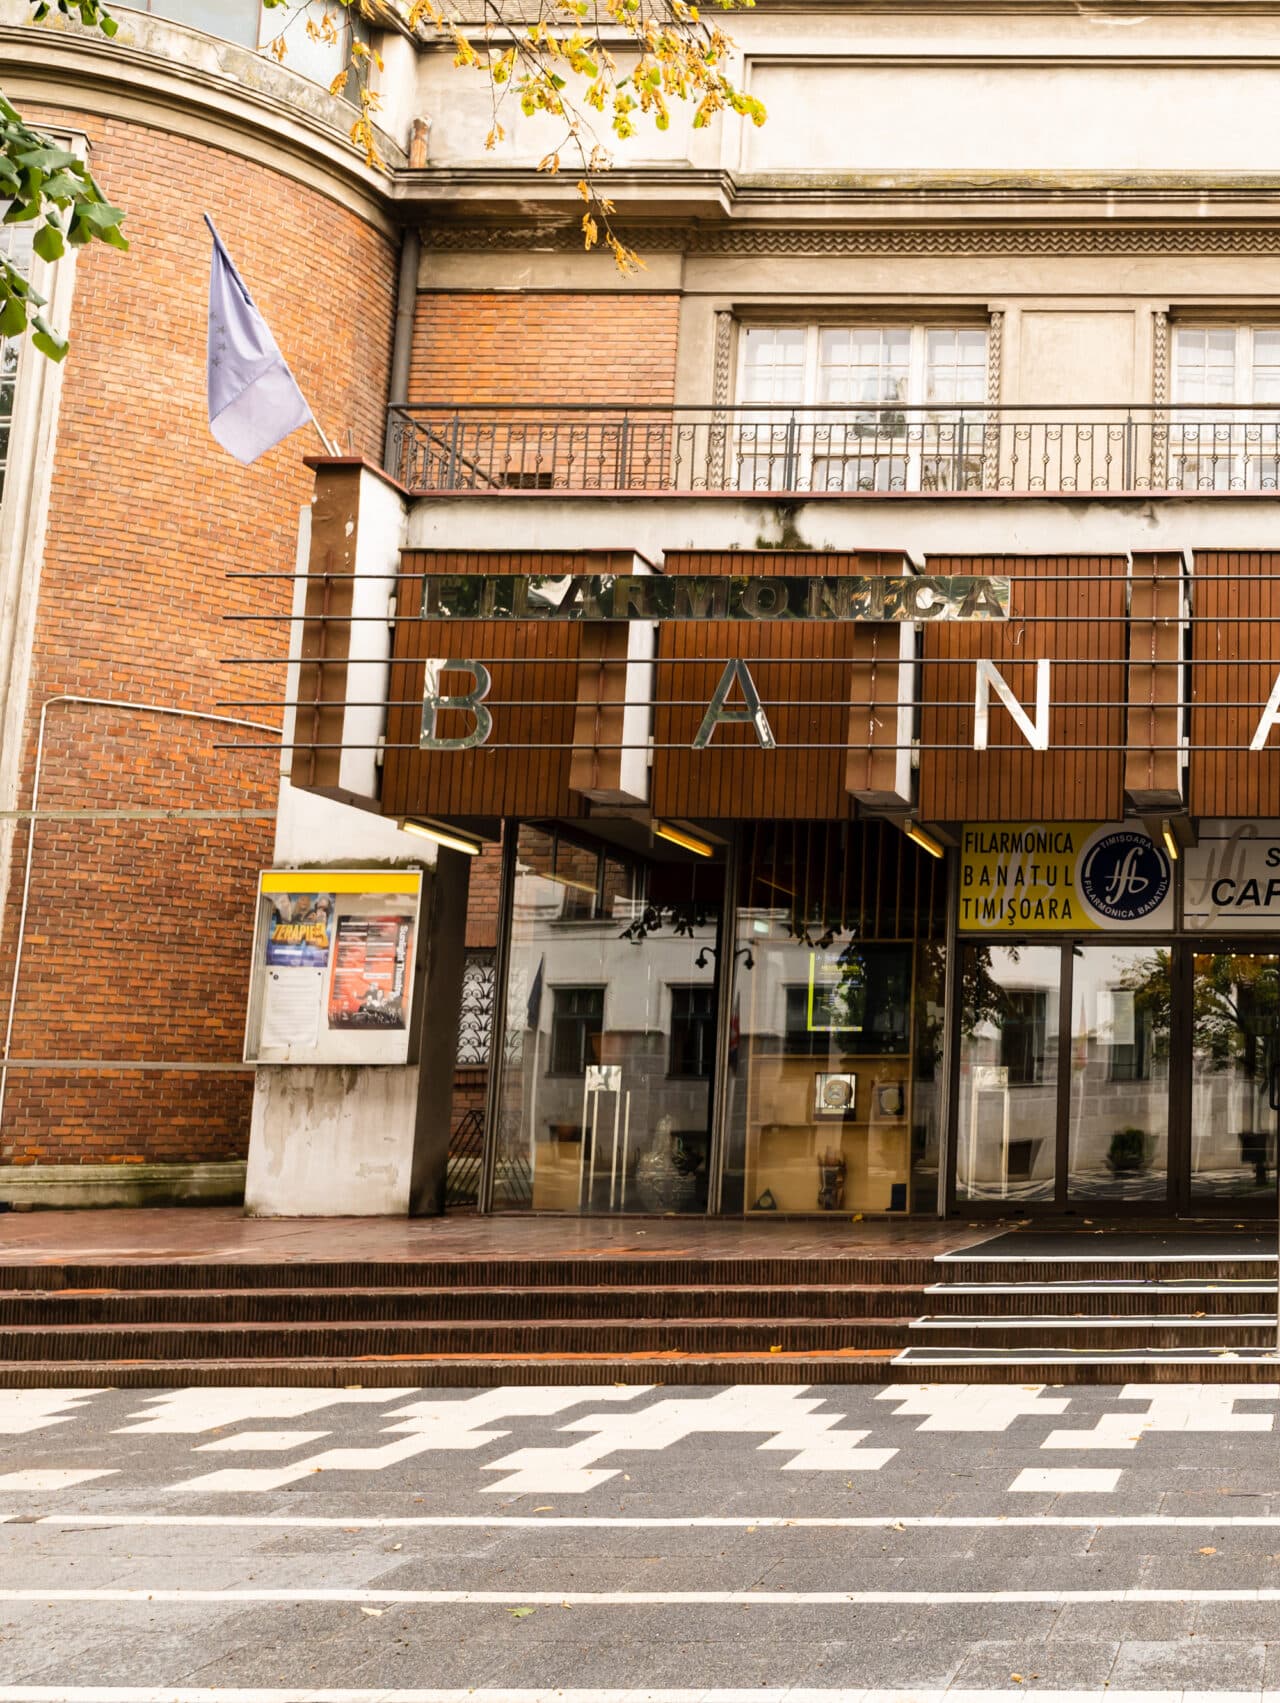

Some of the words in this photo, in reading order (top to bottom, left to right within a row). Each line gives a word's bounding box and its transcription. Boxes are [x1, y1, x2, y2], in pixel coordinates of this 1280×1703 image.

[426, 577, 1005, 618] FILARMONICA
[965, 832, 1073, 854] FILARMONICA
[964, 865, 1073, 887] BANATUL
[1084, 879, 1134, 918] FILARMONICA
[1138, 879, 1168, 915] BANATUL
